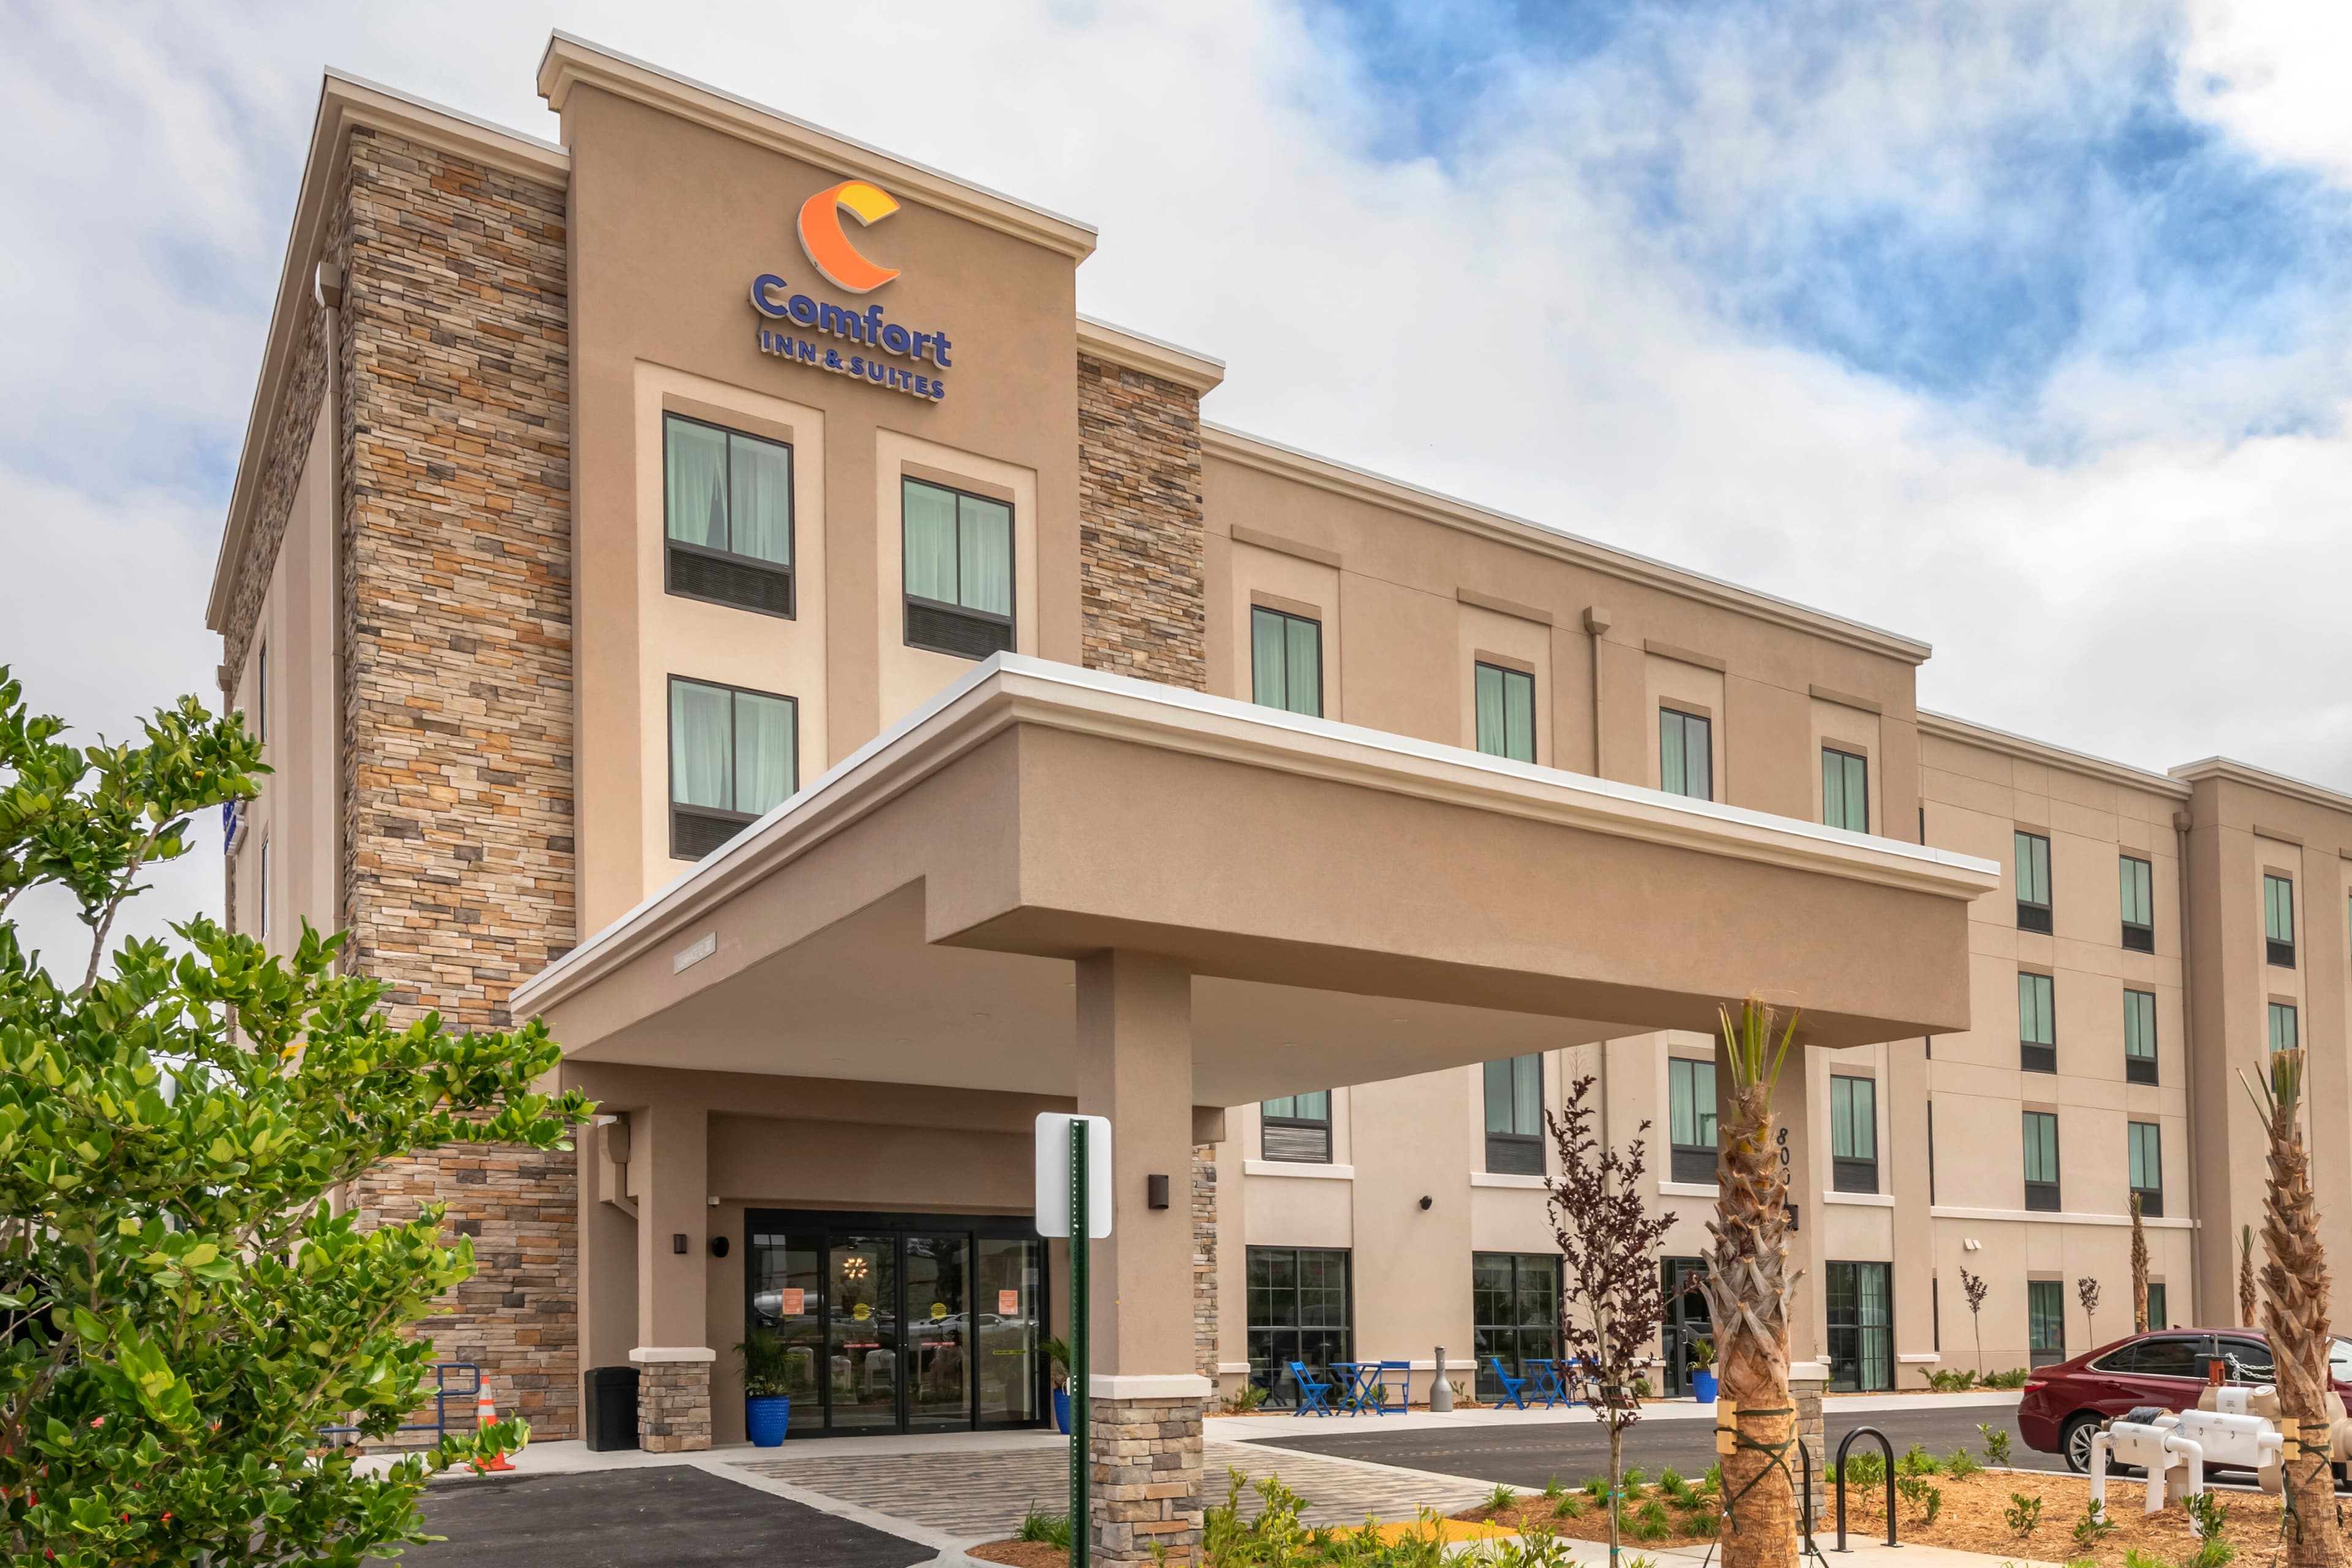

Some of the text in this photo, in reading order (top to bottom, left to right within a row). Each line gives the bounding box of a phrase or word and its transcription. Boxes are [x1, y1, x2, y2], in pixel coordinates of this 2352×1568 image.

[752, 274, 952, 367] Comfort
[763, 330, 945, 401] INN & SUITES
